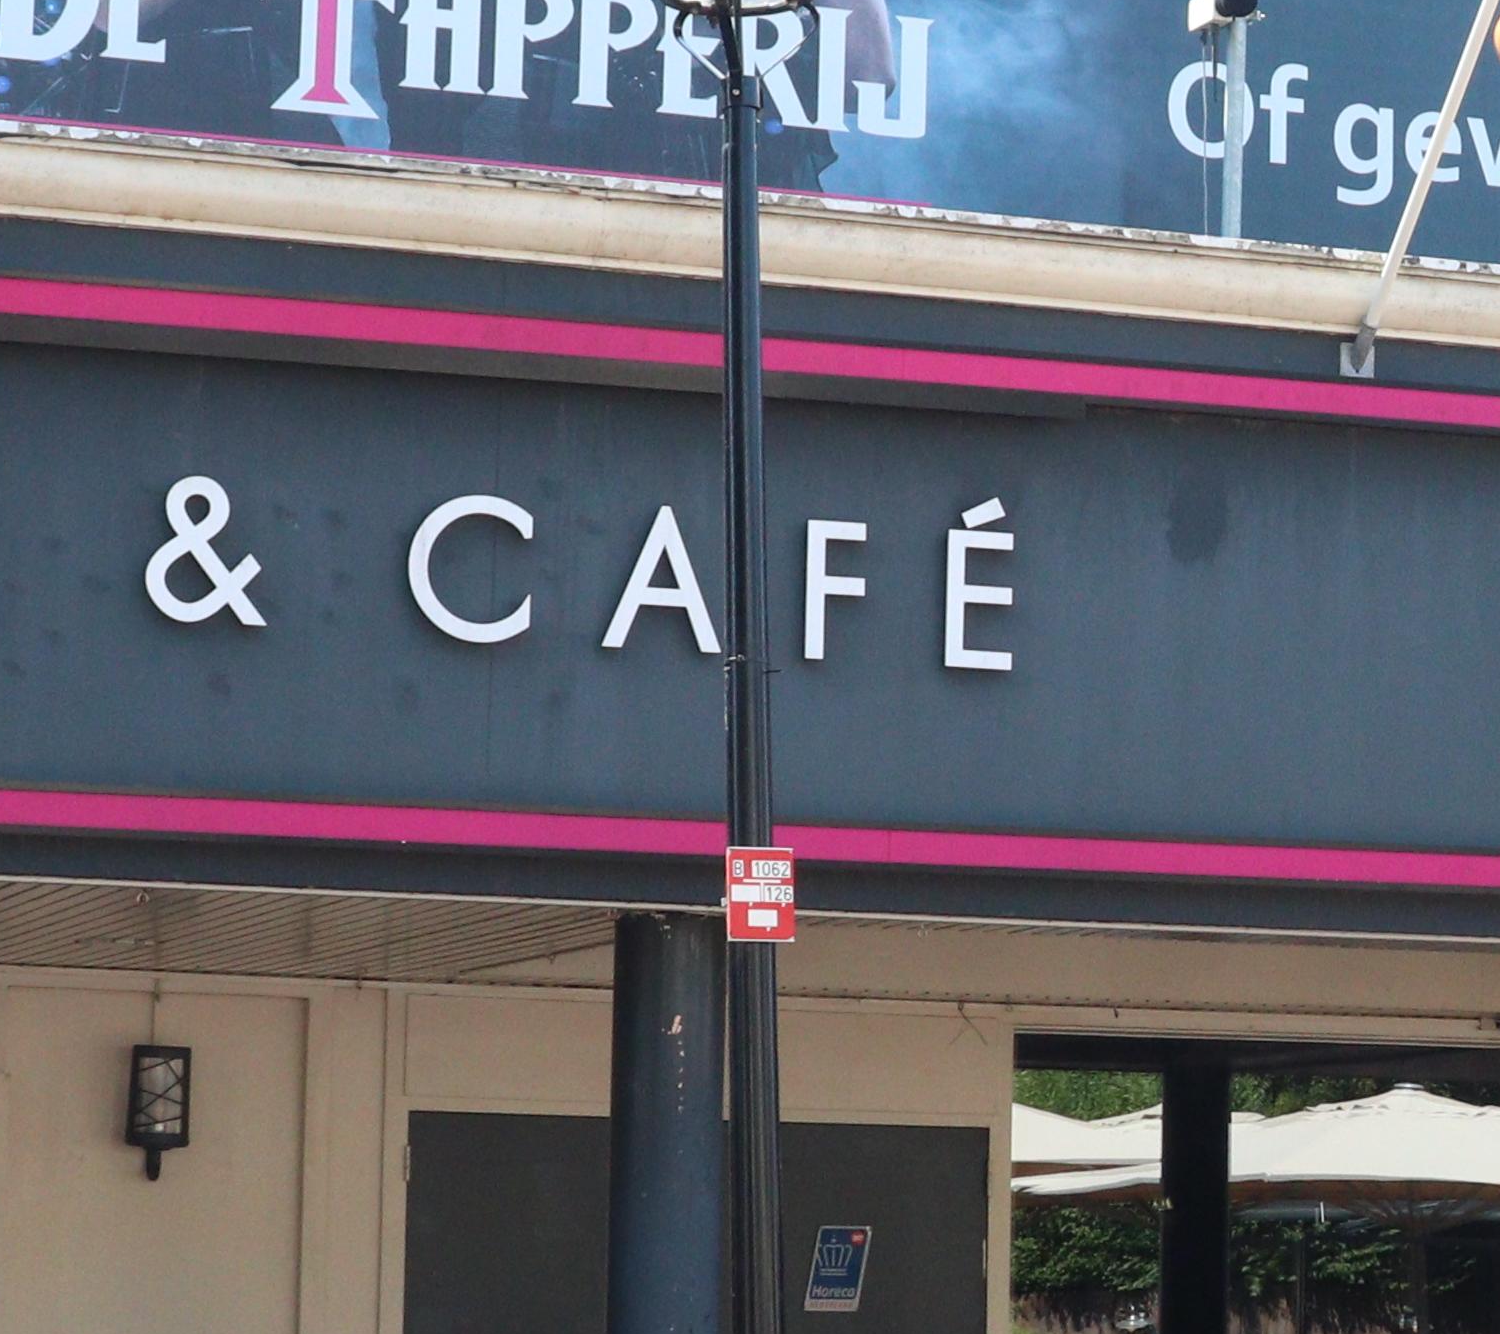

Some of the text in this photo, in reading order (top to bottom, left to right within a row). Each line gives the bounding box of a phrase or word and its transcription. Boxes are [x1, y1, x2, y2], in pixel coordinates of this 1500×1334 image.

[1167, 59, 1308, 167] Of
[145, 475, 266, 627] &
[407, 493, 1014, 672] CAFÉ
[754, 861, 790, 877] 1062
[767, 887, 793, 901] 126
